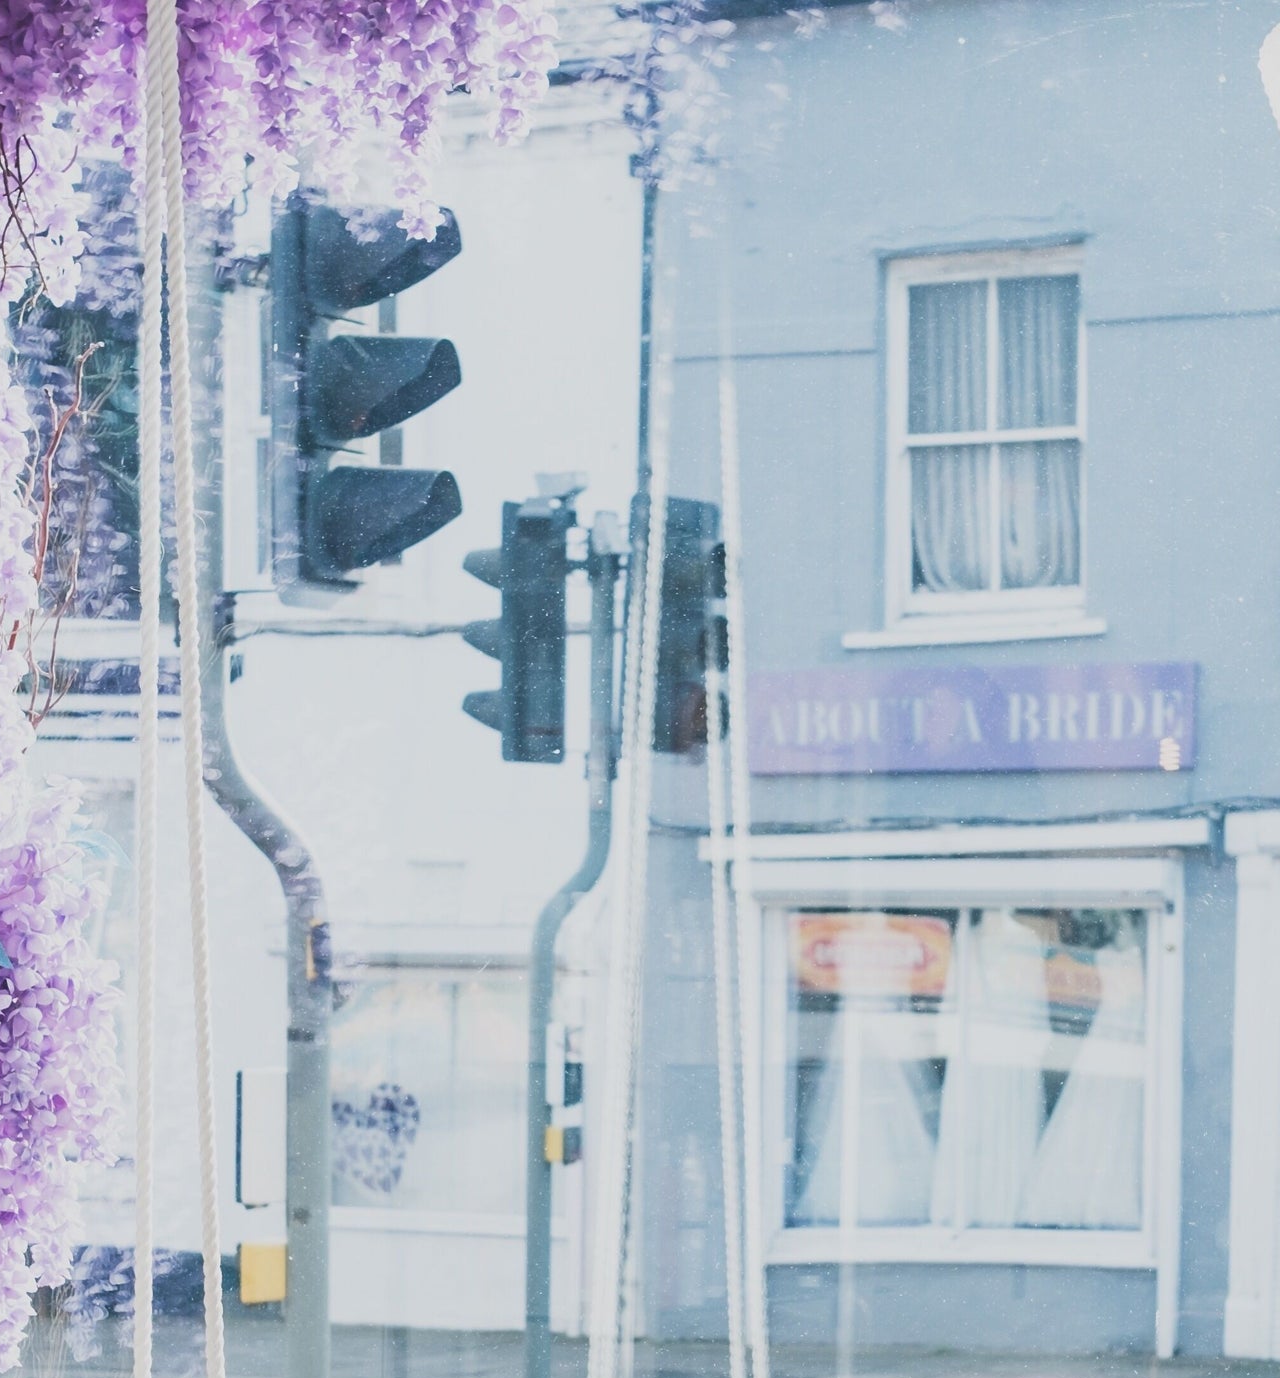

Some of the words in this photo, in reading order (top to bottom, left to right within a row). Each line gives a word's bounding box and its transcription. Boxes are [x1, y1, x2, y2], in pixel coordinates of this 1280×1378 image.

[765, 696, 934, 746] ABOUT
[948, 697, 983, 743] A
[1006, 689, 1184, 742] BRIDE
